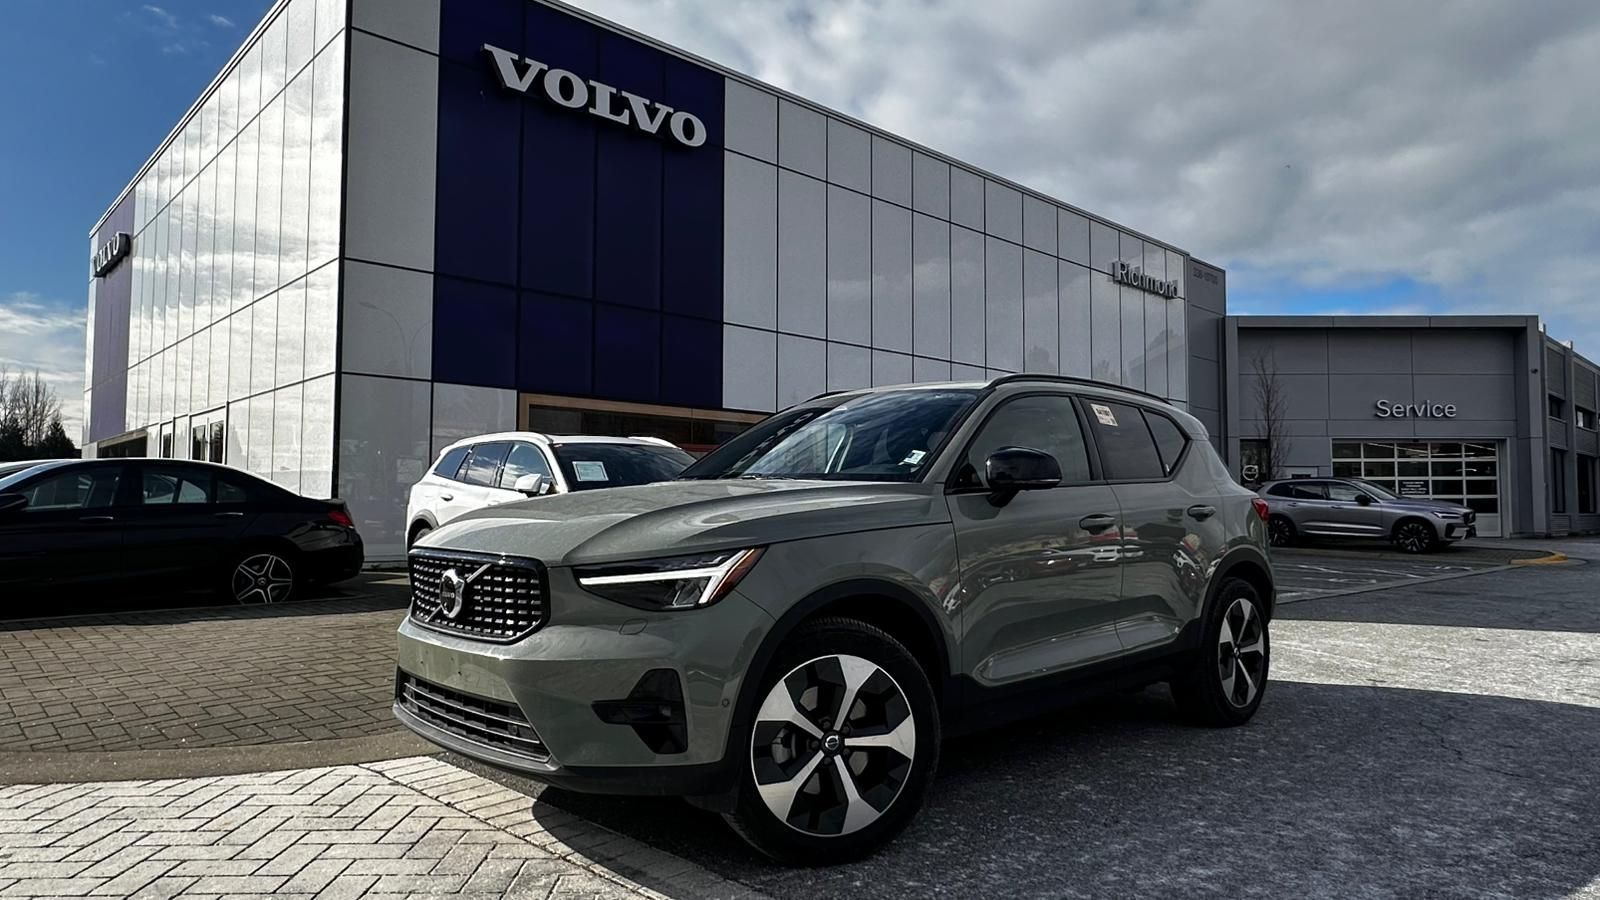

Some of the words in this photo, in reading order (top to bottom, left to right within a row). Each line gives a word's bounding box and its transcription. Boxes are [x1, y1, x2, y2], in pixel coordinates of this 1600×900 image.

[483, 43, 707, 147] VOLVO
[1116, 261, 1178, 298] Richmond
[1376, 399, 1457, 417] Service
